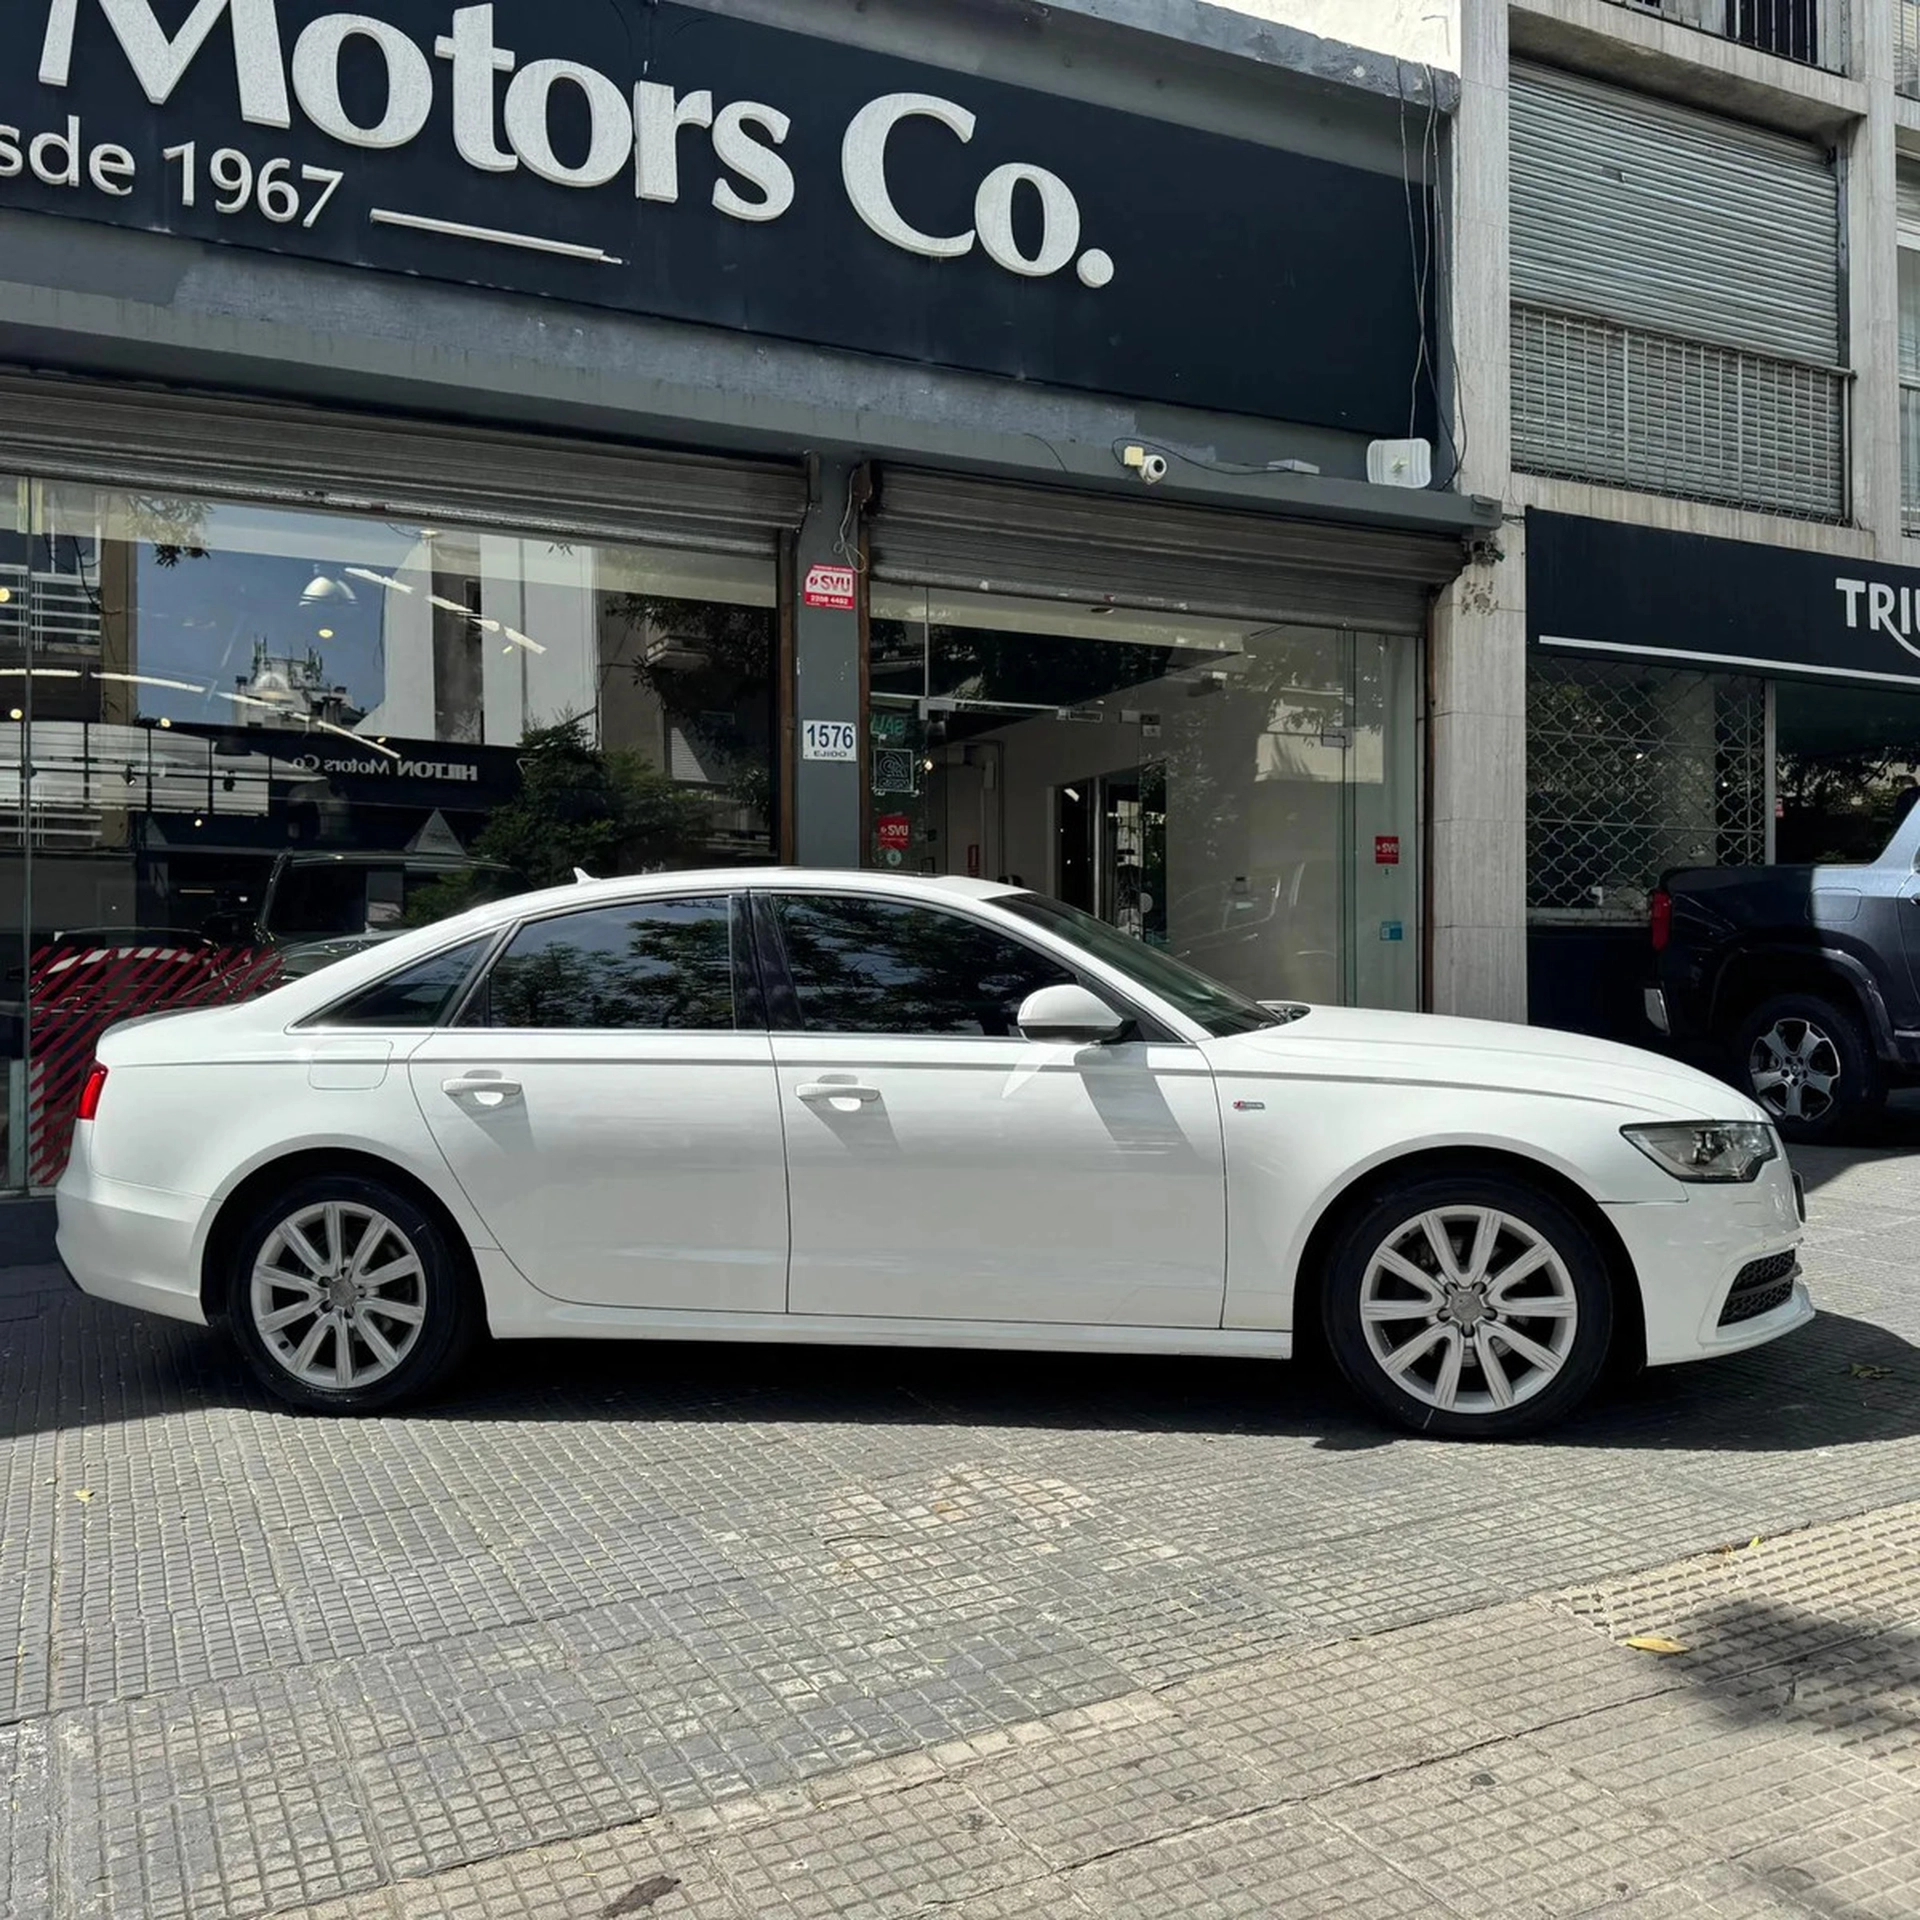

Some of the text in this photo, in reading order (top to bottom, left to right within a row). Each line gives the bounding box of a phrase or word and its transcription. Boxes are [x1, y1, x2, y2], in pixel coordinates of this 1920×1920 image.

[39, 0, 1115, 288] Motors Co.
[163, 141, 345, 228] 1967
[820, 575, 851, 592] SVU
[1835, 577, 1920, 659] TRI
[807, 724, 853, 749] 1576
[887, 824, 909, 836] SVU
